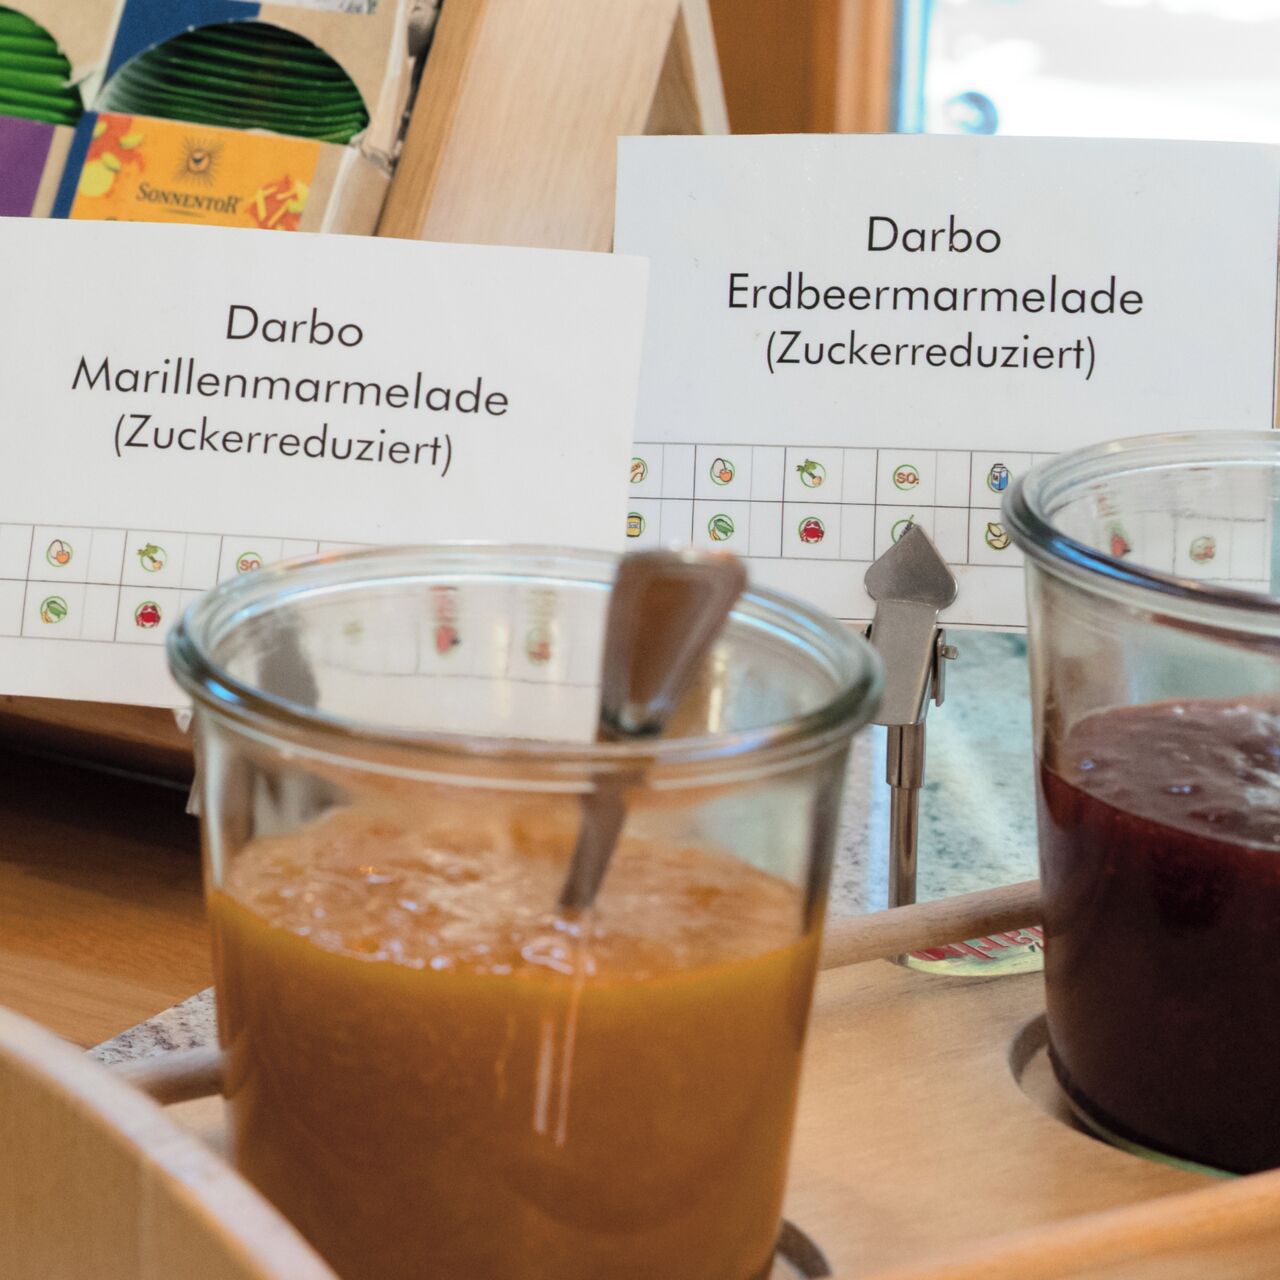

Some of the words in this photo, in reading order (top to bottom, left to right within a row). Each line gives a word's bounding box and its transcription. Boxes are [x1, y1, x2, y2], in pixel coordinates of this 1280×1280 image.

[135, 181, 244, 215] SONNENTOR
[866, 213, 1002, 254] Darbo
[727, 271, 1144, 316] Erdbeermarmelade
[225, 304, 364, 348] Darbo
[765, 329, 1096, 381] (Zuckerreduziert)
[71, 354, 510, 417] Marillenmarmelade
[113, 413, 454, 478] (Zuckerreduziert)
